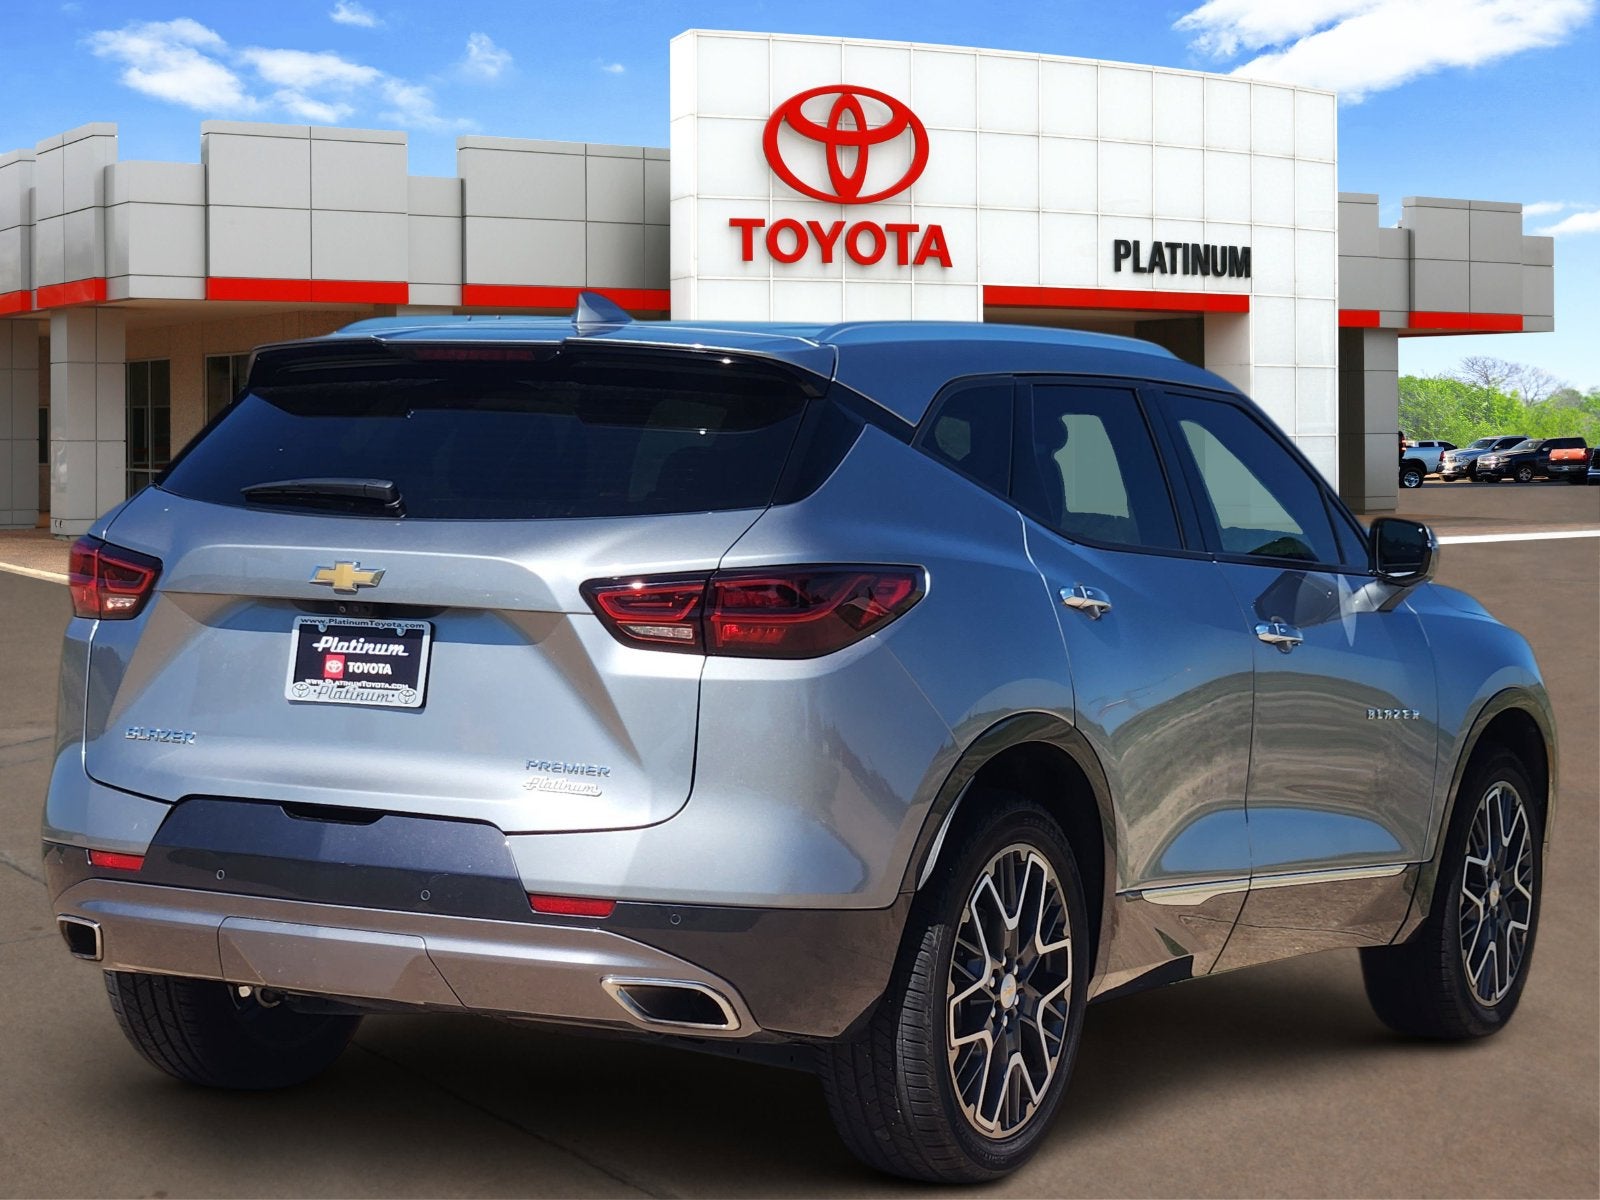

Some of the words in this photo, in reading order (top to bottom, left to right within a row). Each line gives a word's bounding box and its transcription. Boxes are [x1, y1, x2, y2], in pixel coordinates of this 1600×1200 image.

[729, 218, 953, 267] TOYOTA
[1114, 239, 1251, 278] PLATINUM
[301, 618, 425, 629] www.PlatinumToyota.com
[312, 636, 409, 656] Platinum
[347, 662, 392, 675] TOYOTA
[318, 685, 393, 702] Platinum
[1367, 708, 1420, 720] BLAZER
[125, 726, 197, 744] BLAZER
[525, 760, 611, 777] PREMIER
[522, 775, 602, 797] Platinum
